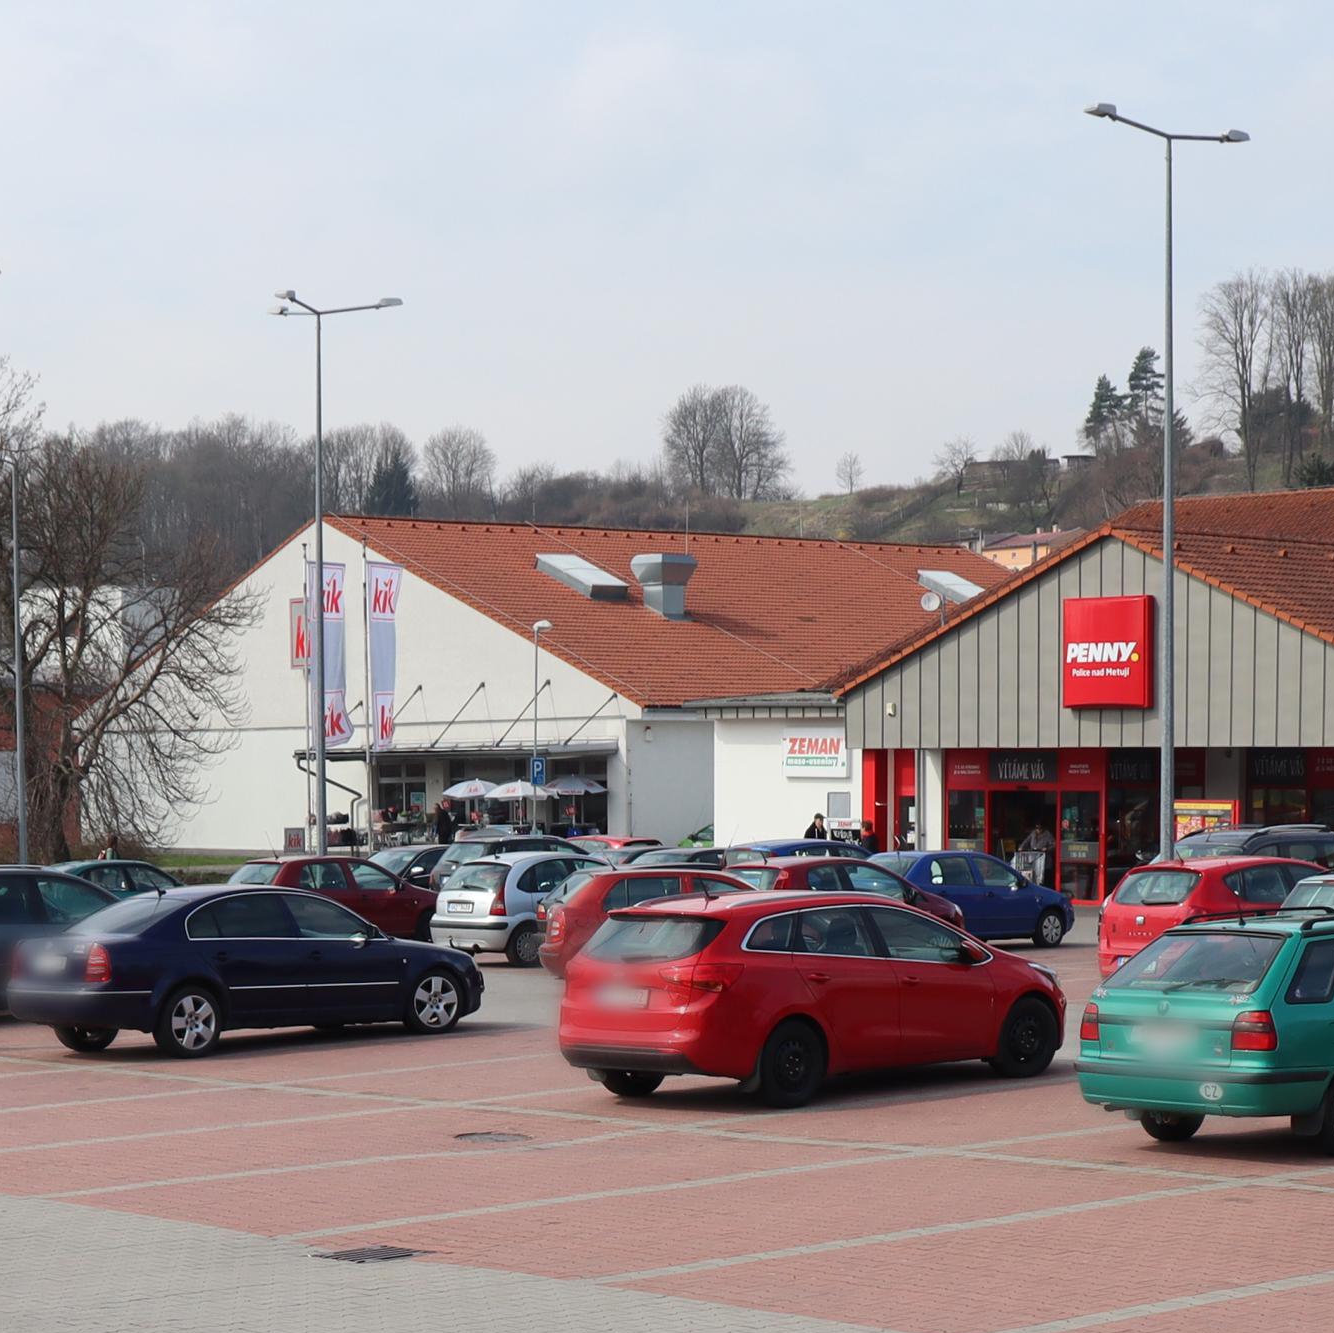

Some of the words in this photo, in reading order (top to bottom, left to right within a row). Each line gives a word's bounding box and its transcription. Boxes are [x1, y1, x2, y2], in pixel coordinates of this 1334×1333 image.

[322, 573, 343, 613] ik
[295, 615, 311, 659] ki
[1072, 668, 1091, 677] Police
[1091, 668, 1105, 677] nad
[1105, 667, 1130, 678] Metují
[324, 703, 346, 738] ik
[380, 704, 395, 740] ki
[787, 737, 841, 755] ZEMAN
[533, 761, 543, 778] P
[998, 757, 1029, 780] VÍTÁME
[1031, 758, 1045, 780] VÁS
[288, 831, 303, 849] kik
[1204, 1084, 1218, 1098] CZ
